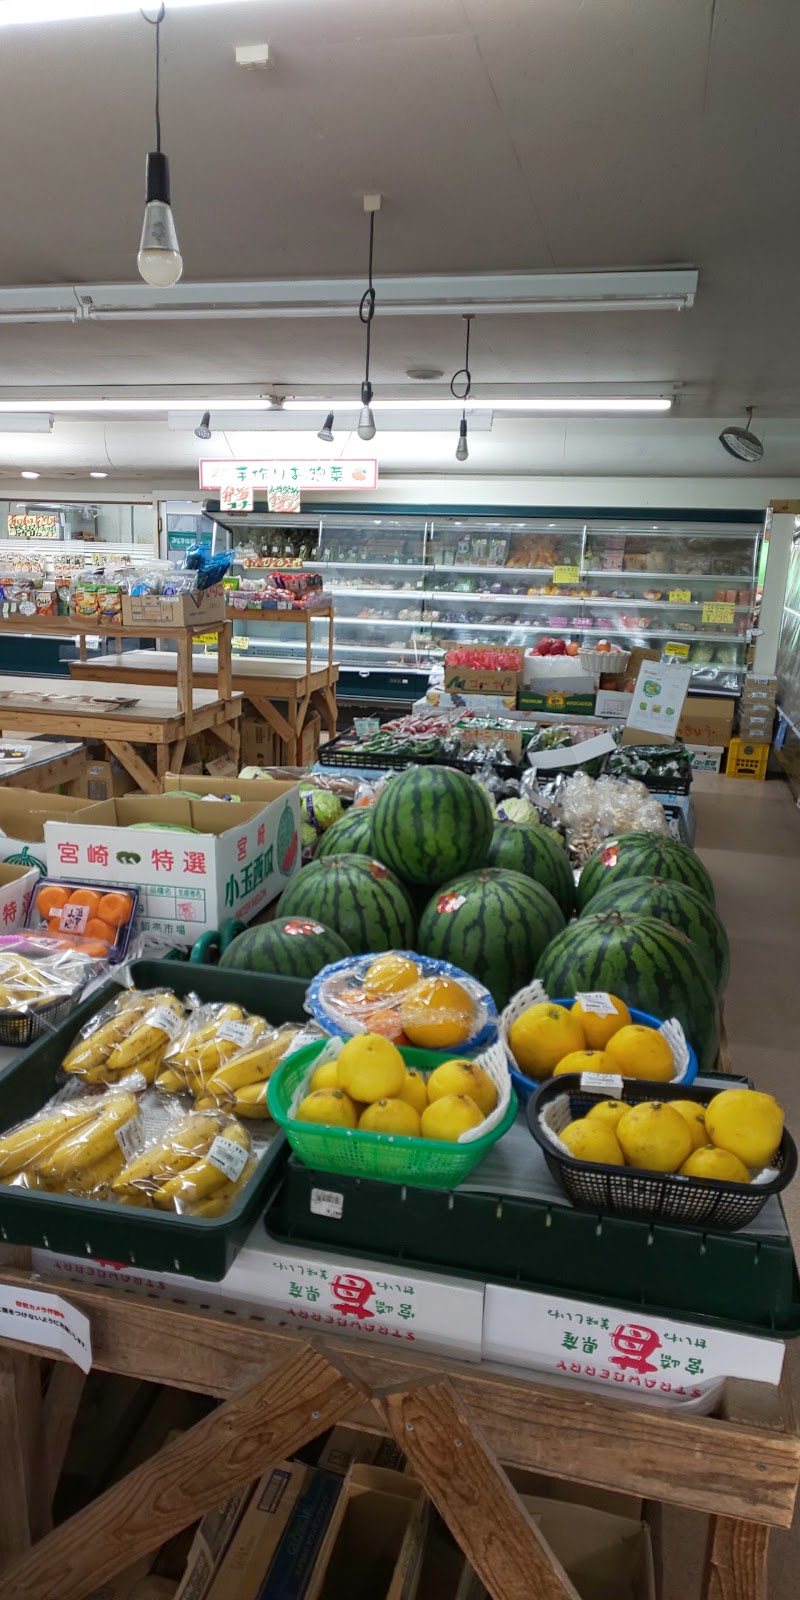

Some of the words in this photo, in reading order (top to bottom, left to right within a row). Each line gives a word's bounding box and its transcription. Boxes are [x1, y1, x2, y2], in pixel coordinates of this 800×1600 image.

[57, 842, 109, 867] 宮崎
[151, 848, 208, 874] 特選
[225, 844, 274, 908] 小玉西瓜
[53, 1260, 168, 1290] STRAWBERRY
[288, 1281, 320, 1302] 県産
[287, 1307, 416, 1341] STRAWBERRY
[375, 1300, 415, 1320] 宮崎
[561, 1331, 598, 1355] 県産
[555, 1360, 702, 1399] STRAWBERRY
[660, 1353, 704, 1376] 宮崎
